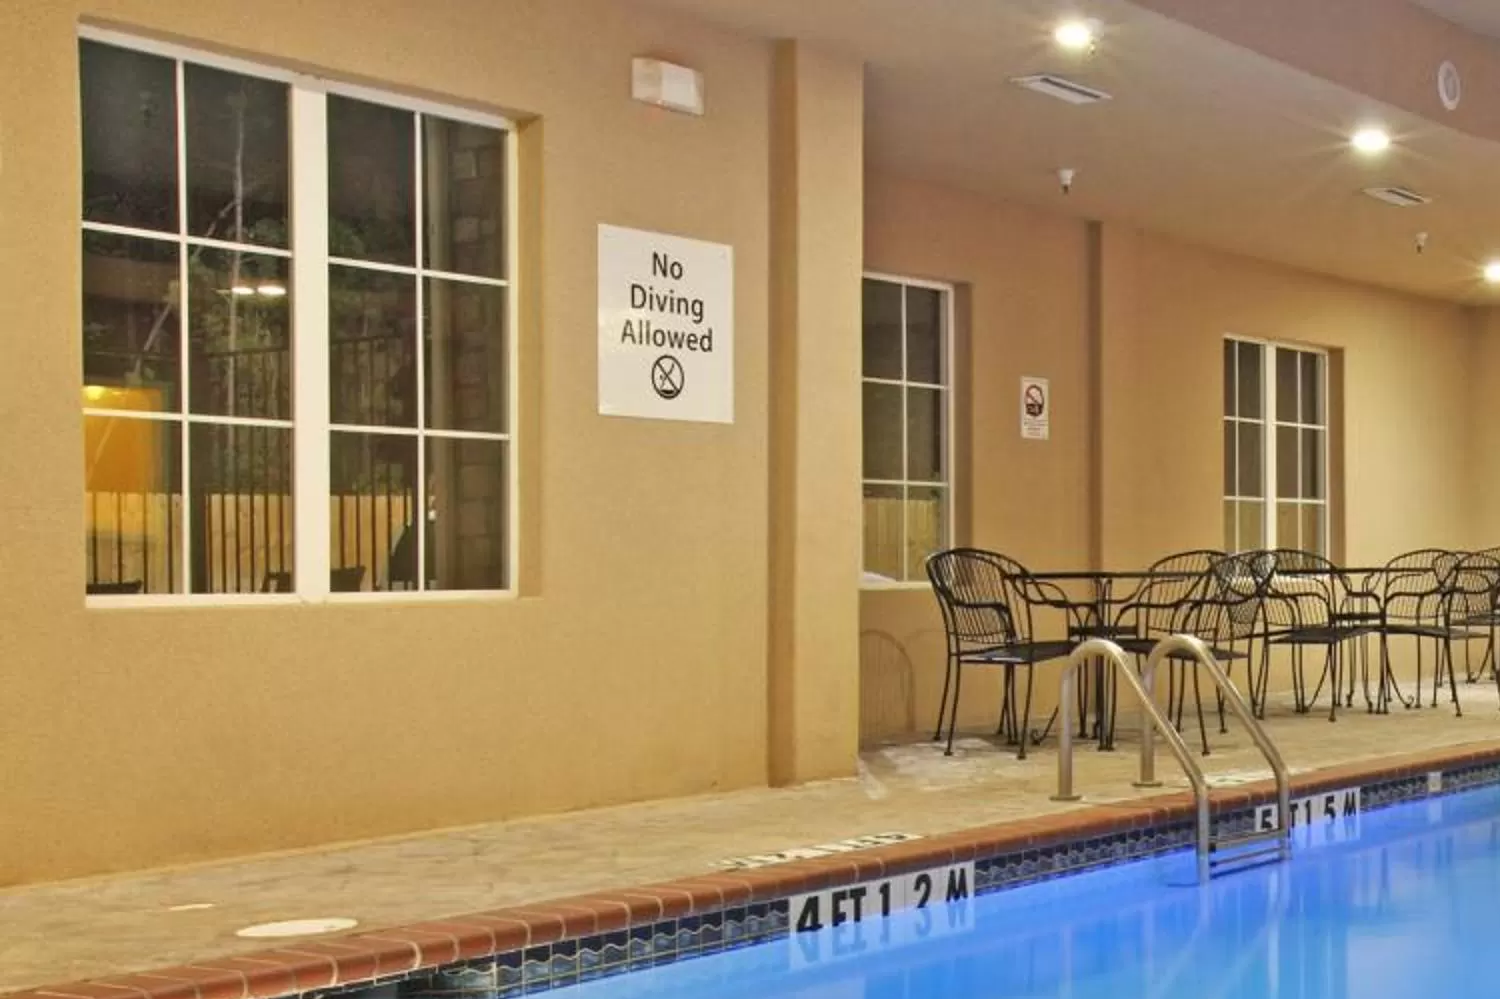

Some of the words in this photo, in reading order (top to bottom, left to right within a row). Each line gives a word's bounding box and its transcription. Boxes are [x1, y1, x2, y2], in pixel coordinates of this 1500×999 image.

[653, 251, 684, 280] No
[631, 283, 704, 324] Diving
[621, 319, 713, 352] Allowed
[796, 895, 824, 933] 4
[832, 886, 867, 927] FT
[945, 867, 969, 902] M
